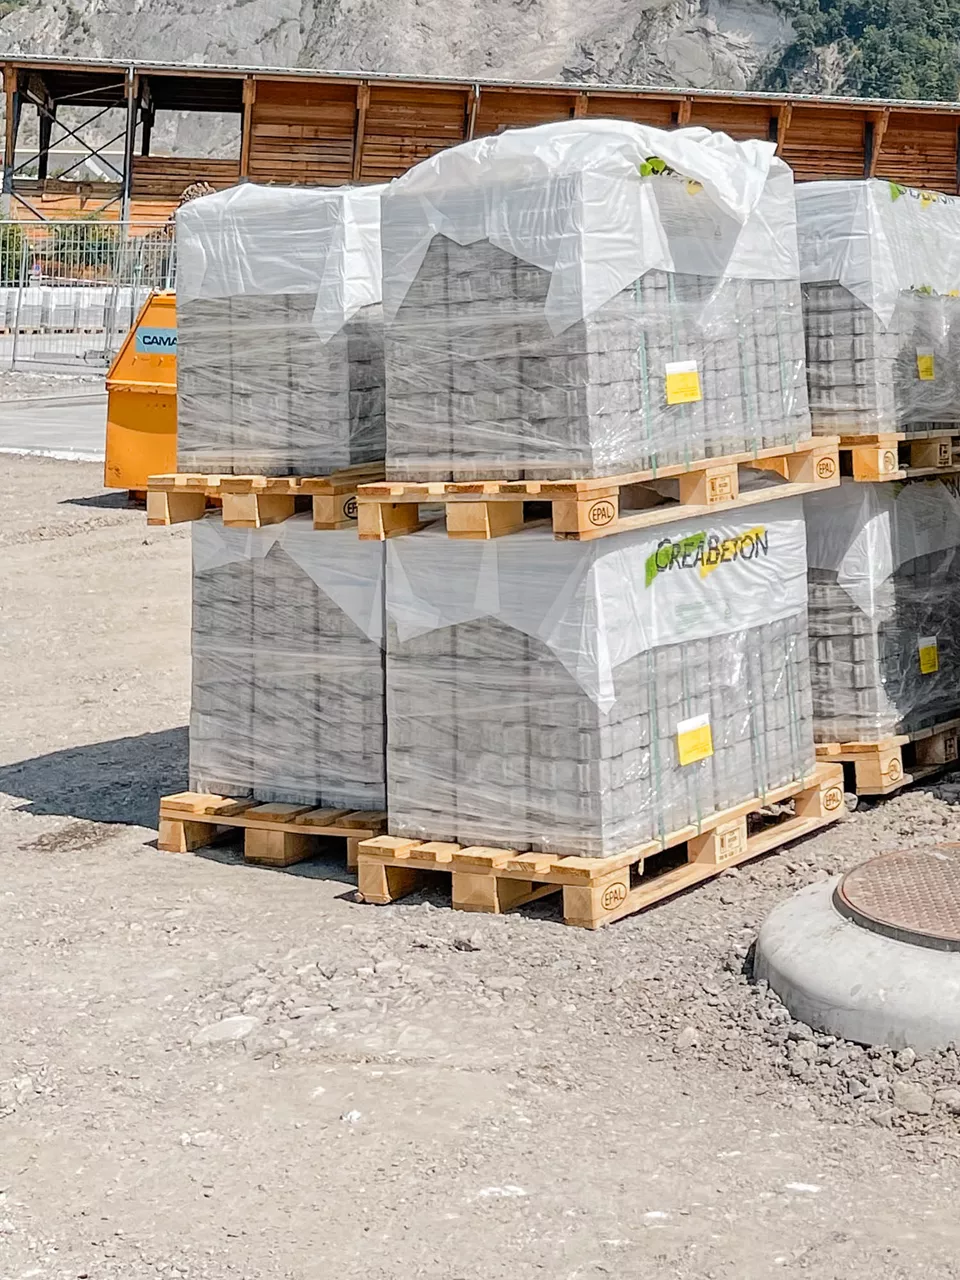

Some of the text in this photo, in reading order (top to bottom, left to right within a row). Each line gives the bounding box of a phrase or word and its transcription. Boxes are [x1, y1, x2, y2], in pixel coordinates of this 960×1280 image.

[819, 462, 833, 475] EPAL
[592, 506, 612, 521] EPAL
[655, 530, 769, 572] CREABETON
[604, 887, 625, 906] EPAL
